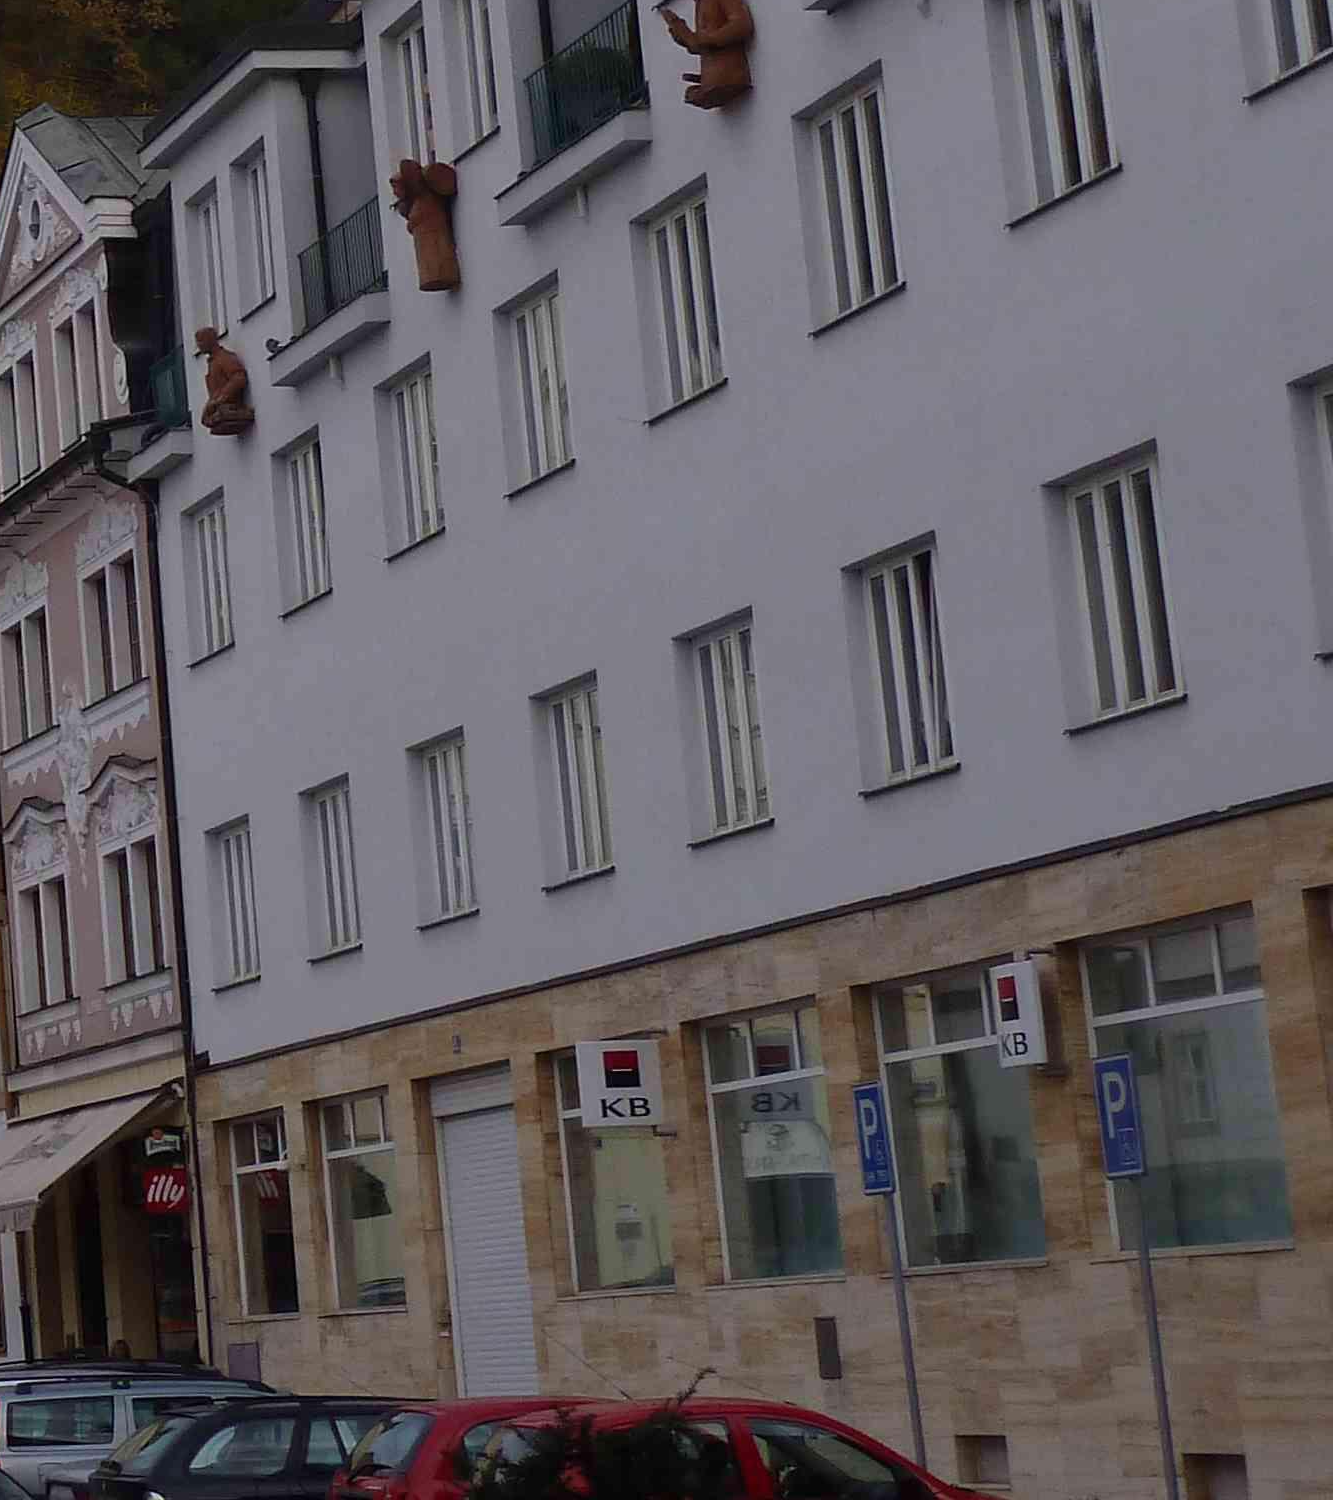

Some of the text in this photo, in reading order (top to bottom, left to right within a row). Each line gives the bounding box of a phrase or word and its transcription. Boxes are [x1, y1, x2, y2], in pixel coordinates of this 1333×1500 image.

[1000, 1032, 1029, 1057] KB
[600, 1097, 651, 1118] KB
[1102, 1072, 1127, 1139] P
[859, 1098, 878, 1160] P
[147, 1175, 184, 1212] illy
